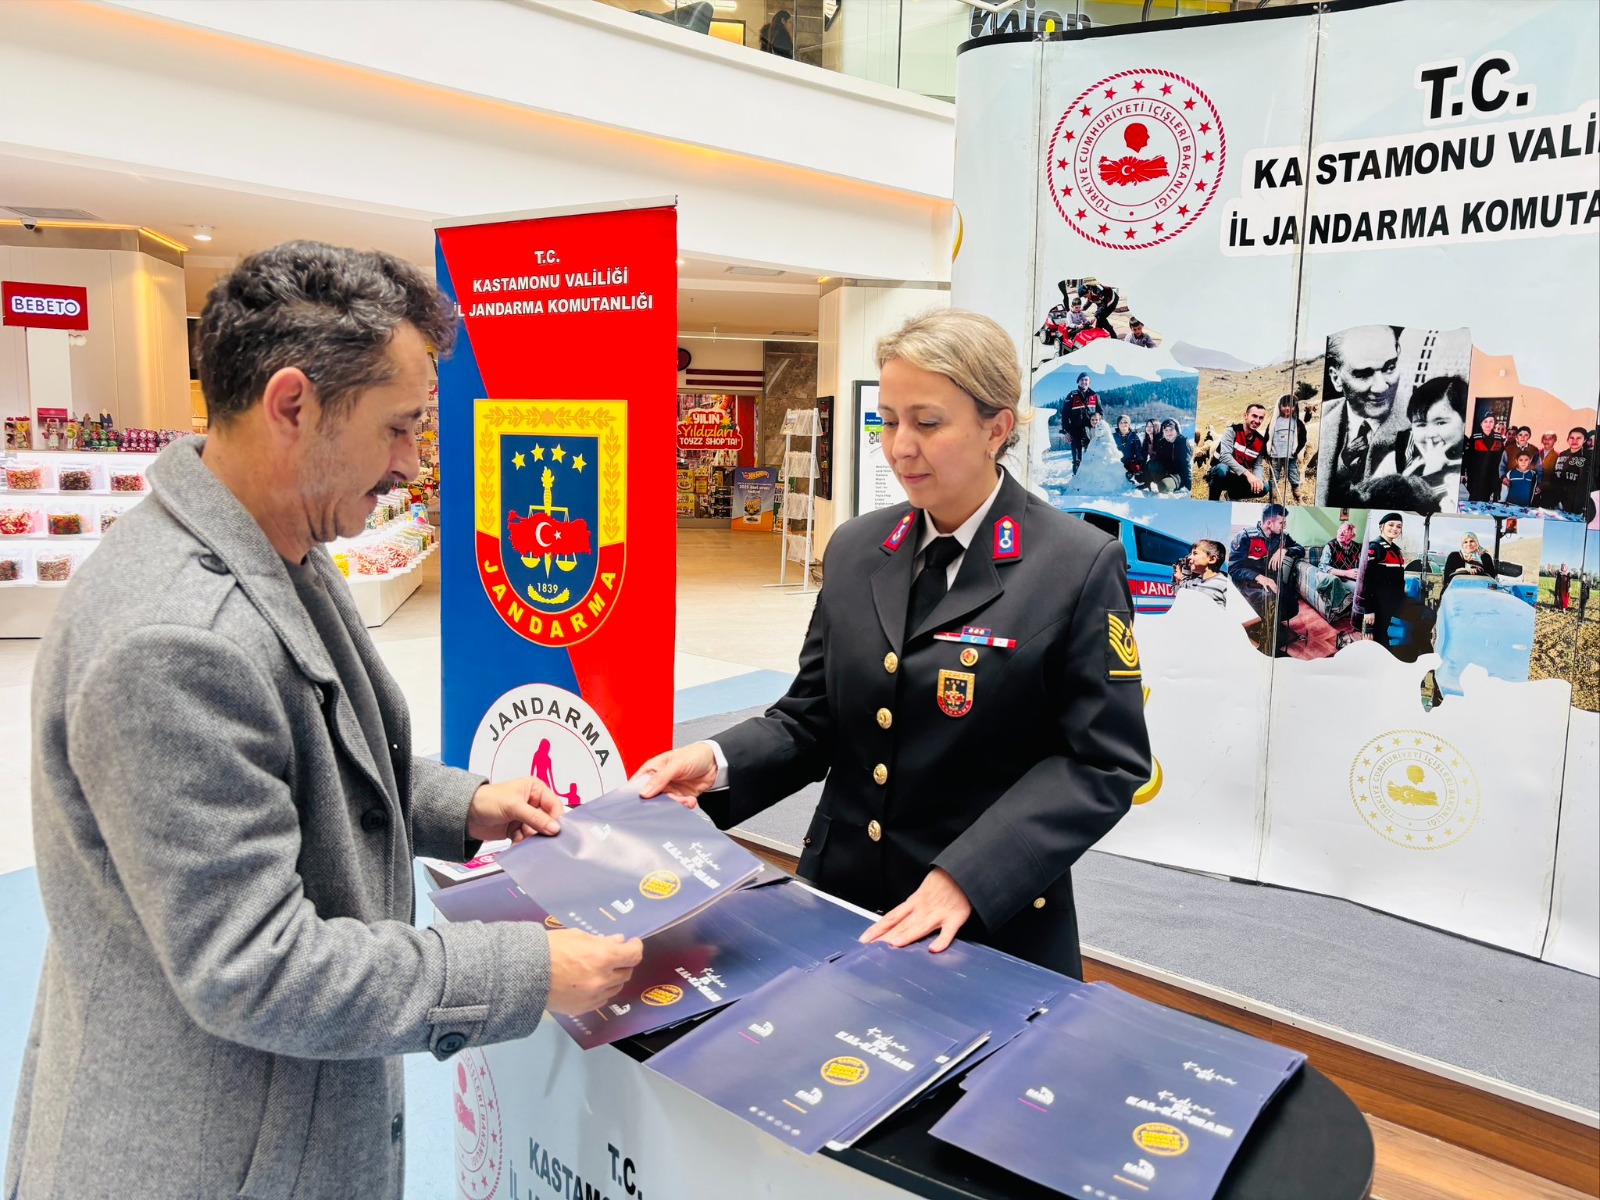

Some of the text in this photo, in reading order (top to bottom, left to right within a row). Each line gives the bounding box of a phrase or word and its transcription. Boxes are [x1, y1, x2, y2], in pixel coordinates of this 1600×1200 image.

[1421, 58, 1529, 119] T.C.
[1508, 112, 1600, 163] VALİ
[1079, 101, 1192, 212] TÜRKİYE CUMHURİYETİ İÇİŞLERİ BAKANLIĞI
[1229, 210, 1255, 247] İL
[1263, 204, 1449, 246] JANDARMA
[534, 249, 560, 265] T.C.
[473, 266, 629, 293] KASTAMONU VALİLİĞİ
[13, 298, 79, 315] BEBETO
[468, 300, 544, 317] JANDARMA
[547, 292, 653, 313] KOMUTANLIĞI
[692, 413, 720, 424] YILIN
[679, 437, 703, 445] TOYZZ
[484, 559, 616, 638] JANDARMA
[537, 582, 559, 594] 1839
[1140, 581, 1177, 597] JAND
[489, 697, 610, 767] JANDARMA
